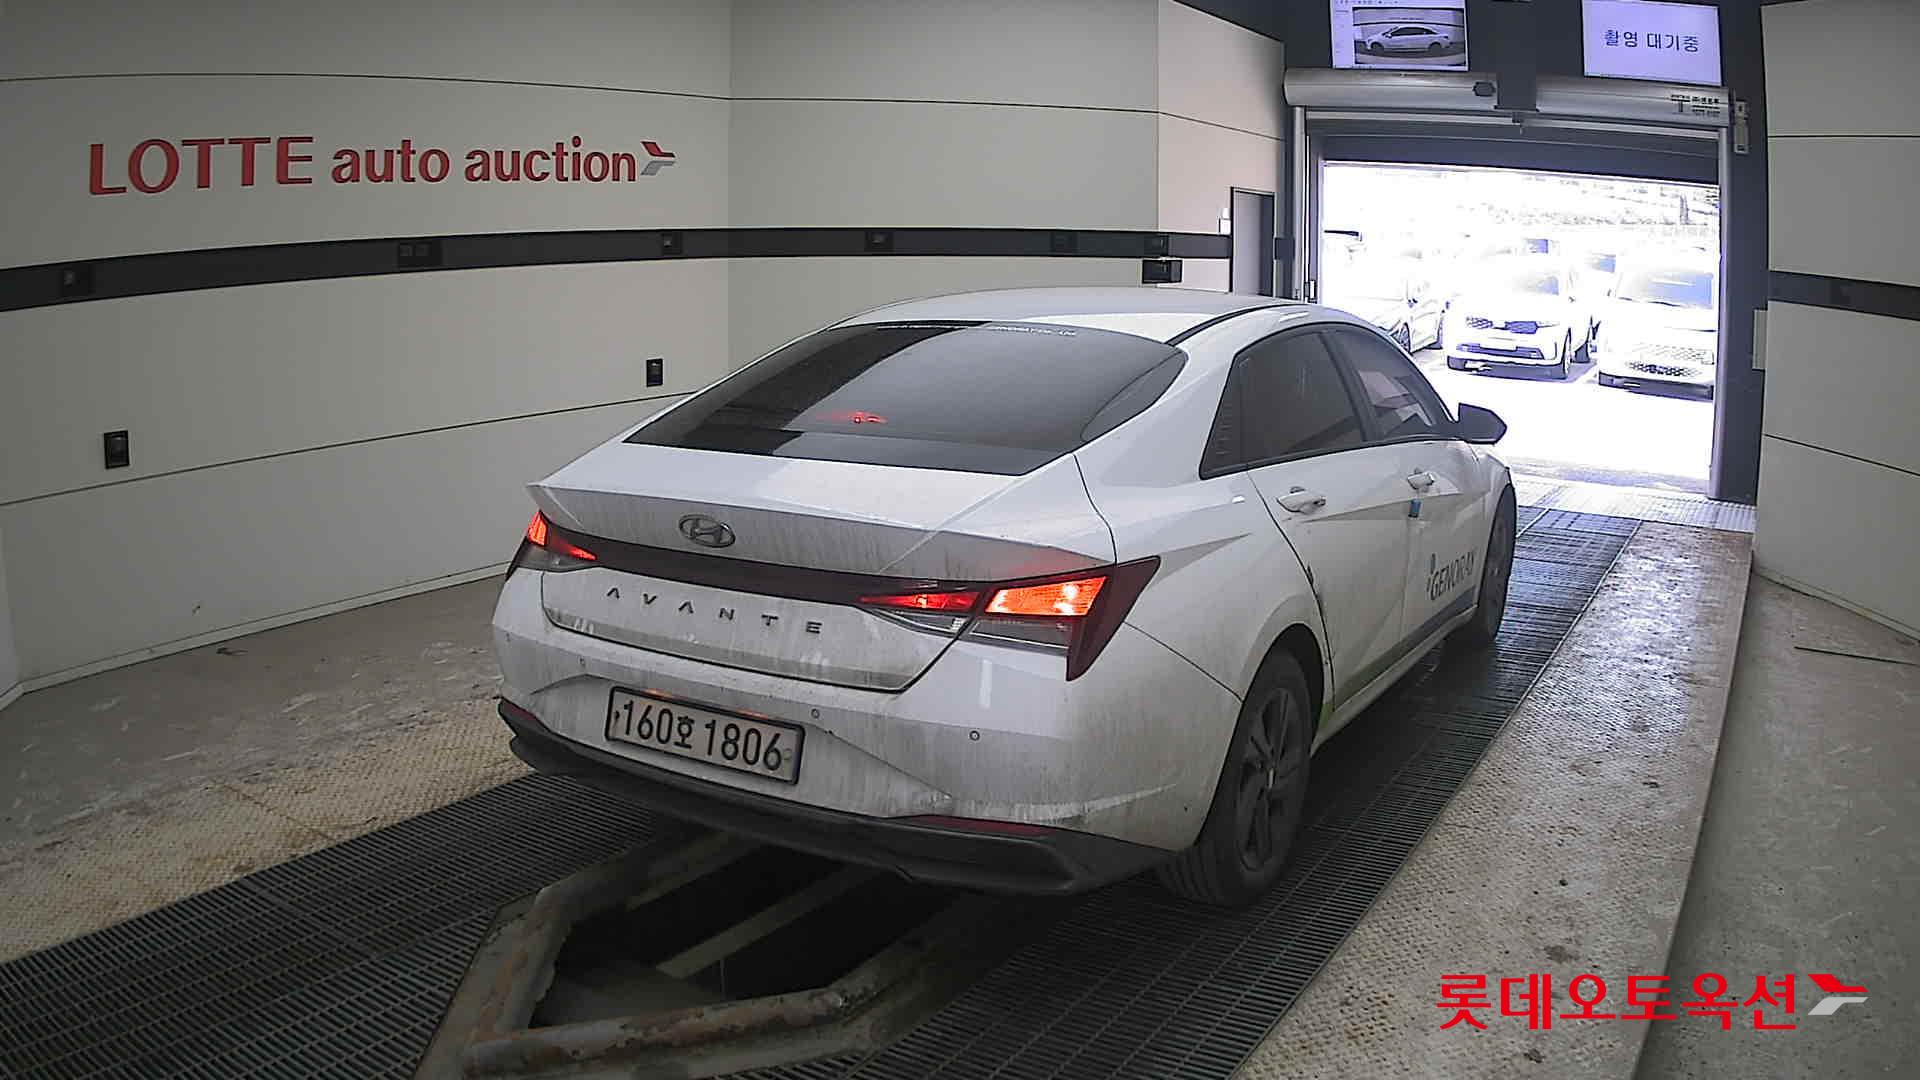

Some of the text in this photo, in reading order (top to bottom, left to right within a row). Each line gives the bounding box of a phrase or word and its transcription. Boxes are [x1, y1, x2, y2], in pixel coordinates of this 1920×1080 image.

[1604, 29, 1699, 53] 촬영 대기중
[89, 136, 637, 195] LOTTE auto auction
[606, 587, 823, 634] AVANTE
[623, 700, 783, 772] 160호 1806
